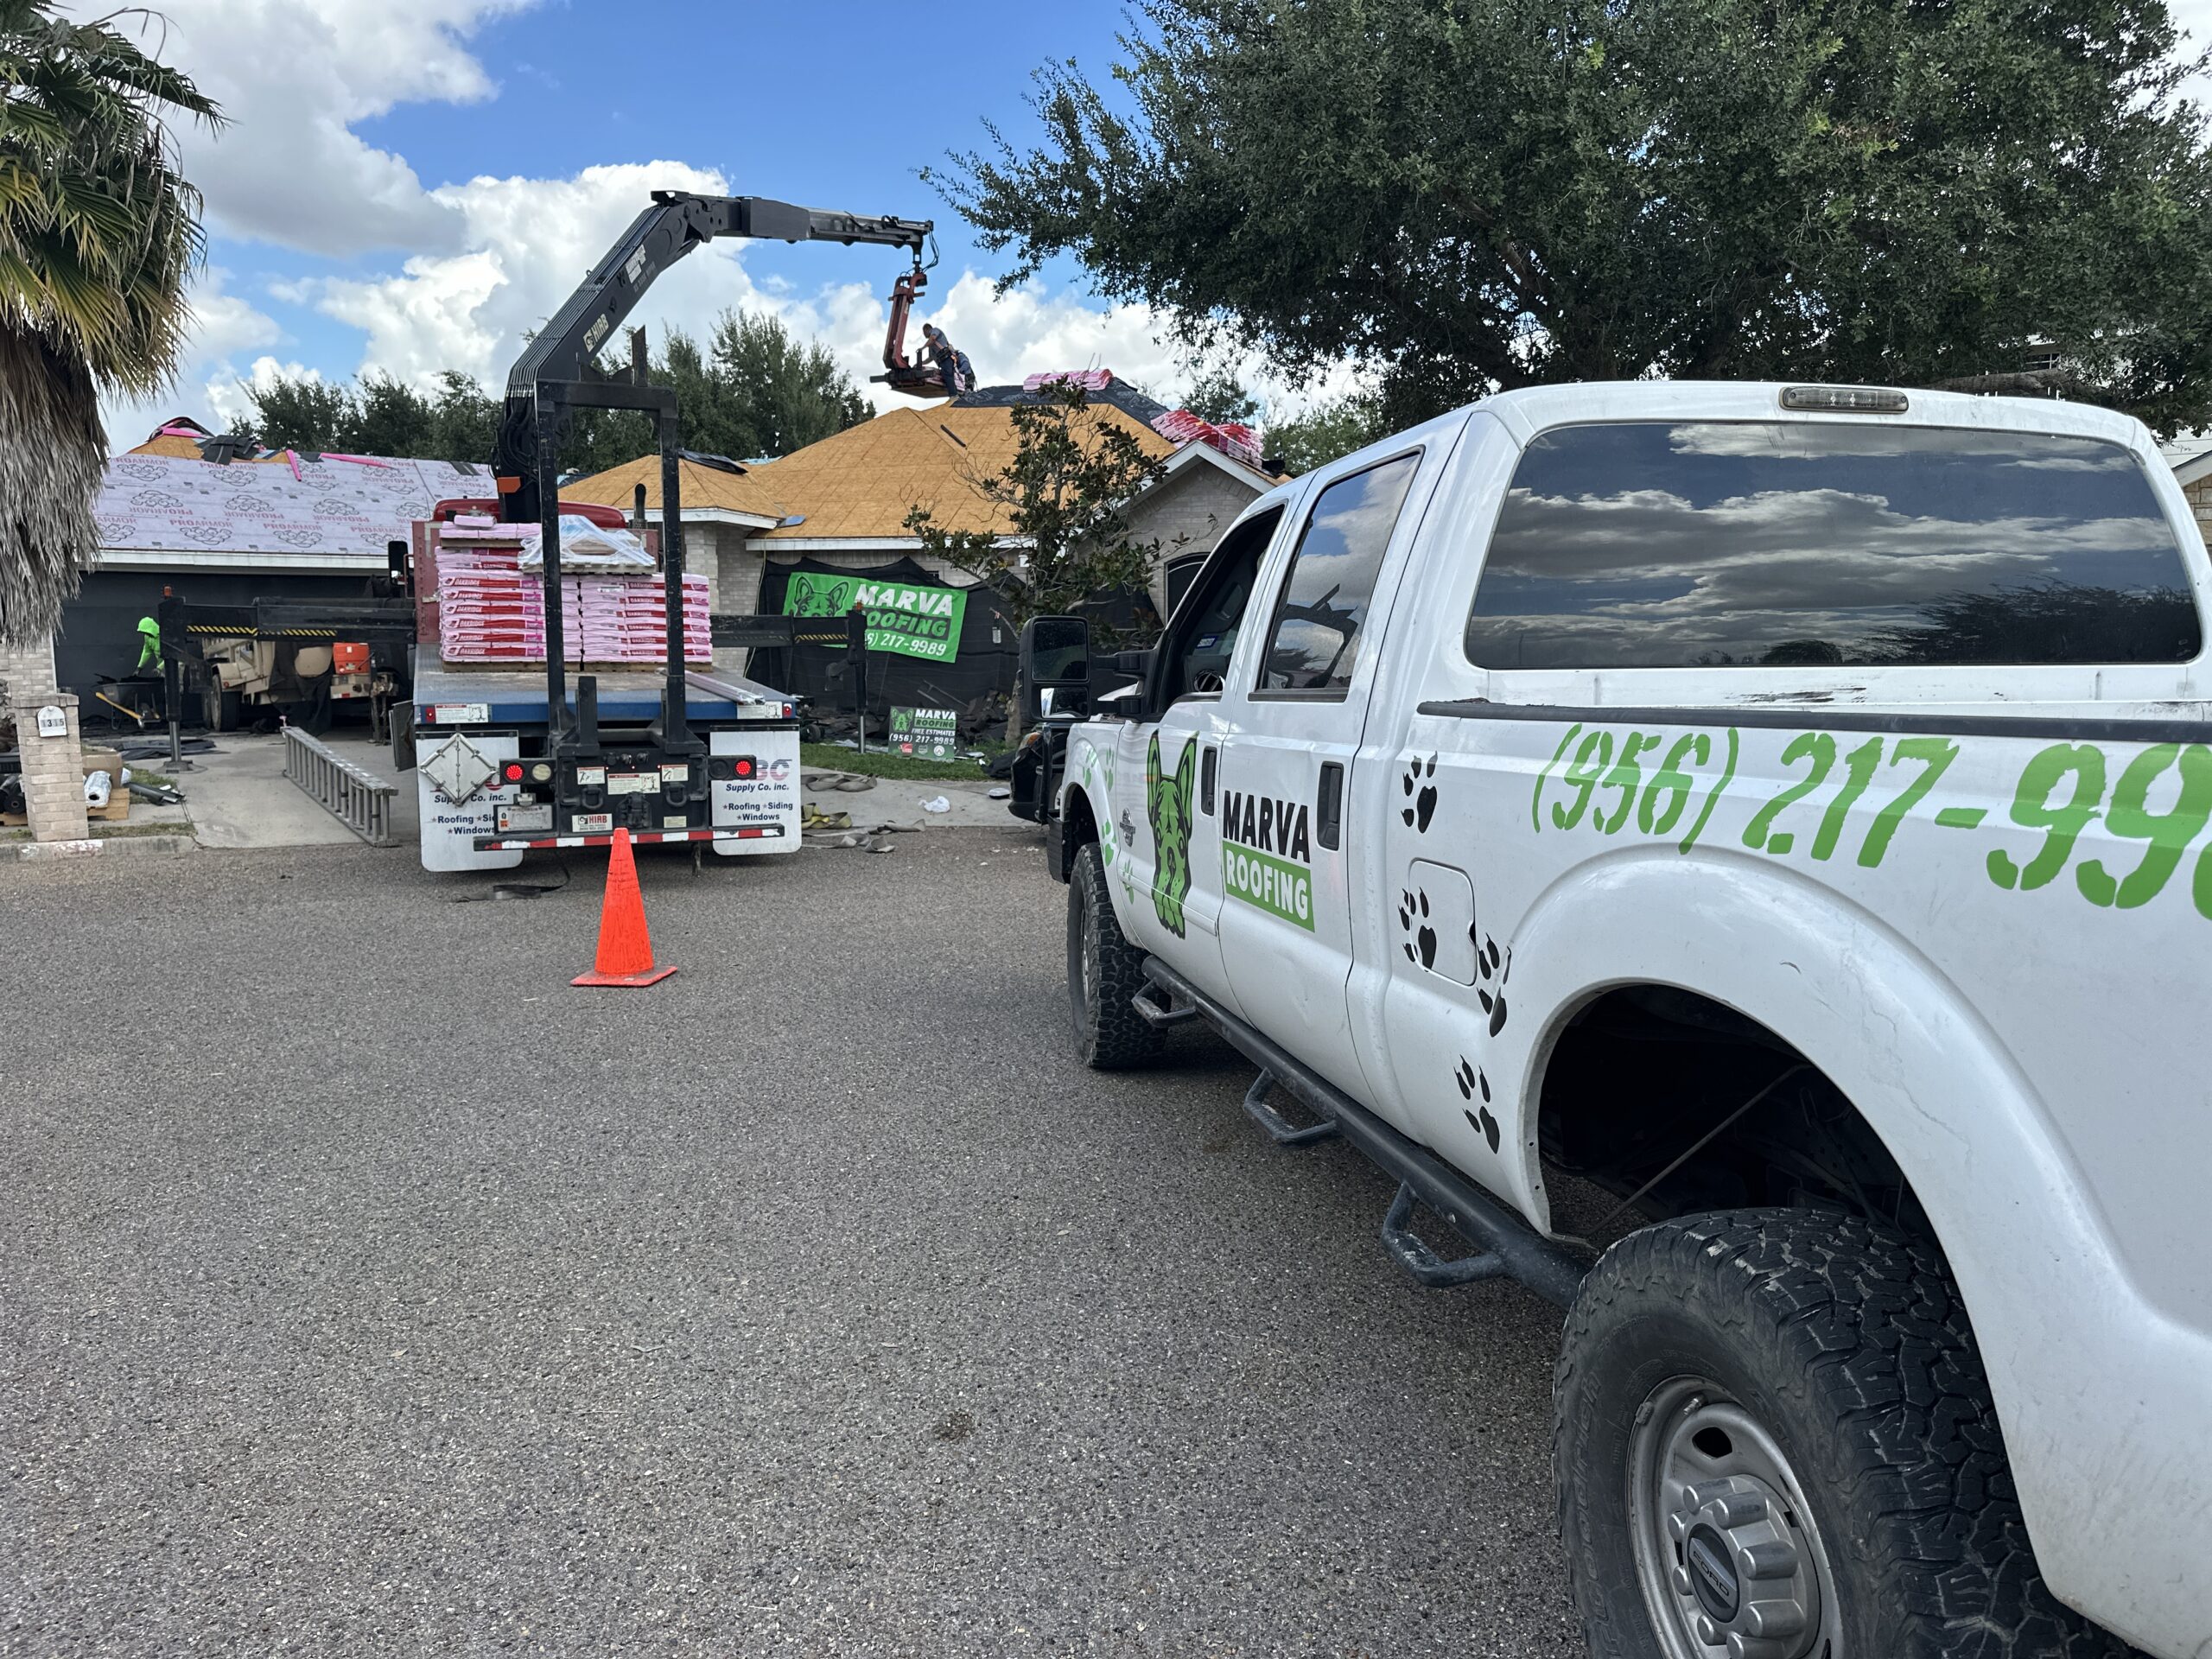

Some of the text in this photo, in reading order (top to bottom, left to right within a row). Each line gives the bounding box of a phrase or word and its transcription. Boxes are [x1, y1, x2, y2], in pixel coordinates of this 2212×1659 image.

[114, 457, 169, 466] ROARMOR
[169, 518, 233, 528] PROARMOR
[263, 522, 323, 532] PROARMOR
[351, 525, 407, 535] PROARMOR
[854, 583, 952, 617] MARVA
[864, 610, 947, 637] OOFING
[880, 632, 947, 657] 217-9989
[915, 709, 957, 721] MARVA
[916, 719, 955, 728] ROOFING
[925, 728, 956, 737] ESTIMATES
[889, 733, 955, 746] (956) 217-9989
[755, 759, 792, 781] BC
[726, 783, 755, 792] Supply
[1532, 723, 1738, 855] (956)
[470, 793, 486, 802] Co.
[489, 793, 507, 802] inc.
[728, 802, 793, 811] Roofing Siding
[437, 815, 474, 824] Roofing
[589, 815, 607, 824] HIAB
[1223, 790, 1311, 864] MARVA
[1226, 854, 1309, 922] ROOFING
[1693, 1550, 1730, 1597] FORD
